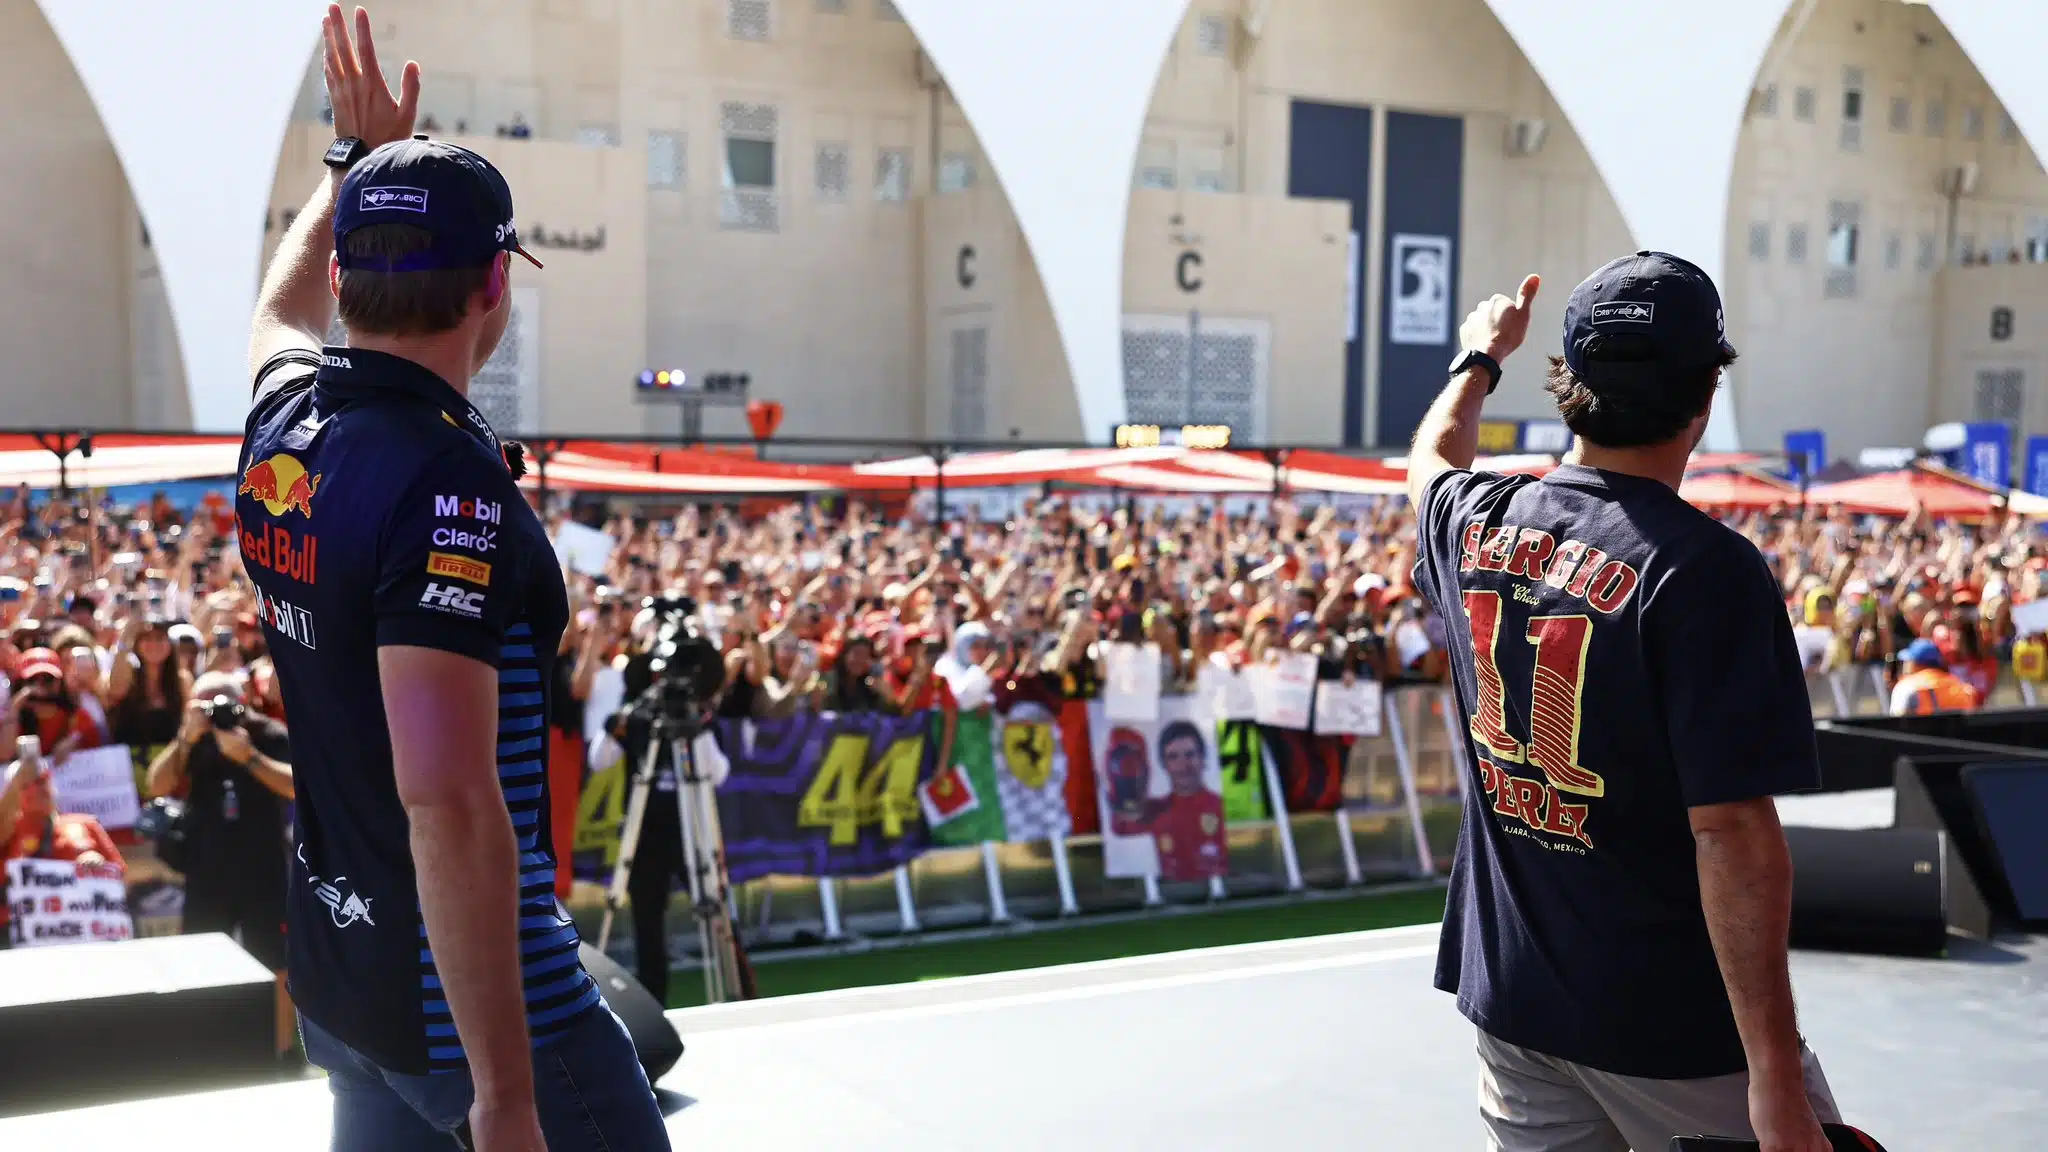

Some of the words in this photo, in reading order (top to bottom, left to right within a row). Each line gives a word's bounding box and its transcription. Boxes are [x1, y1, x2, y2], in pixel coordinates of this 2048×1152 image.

[957, 244, 977, 289] C
[1176, 250, 1204, 293] C
[1990, 305, 2014, 341] B
[466, 406, 498, 450] zoom
[435, 495, 501, 525] Mobil
[236, 511, 271, 569] Red
[274, 526, 317, 584] Bull
[432, 527, 489, 552] Claro
[1460, 522, 1637, 614] SERGIO
[254, 583, 297, 641] Mobil
[299, 611, 310, 644] 1
[420, 582, 486, 614] HRC
[798, 735, 924, 844] 44
[1477, 757, 1594, 850] PEREZ
[1553, 842, 1586, 856] MEXICO
